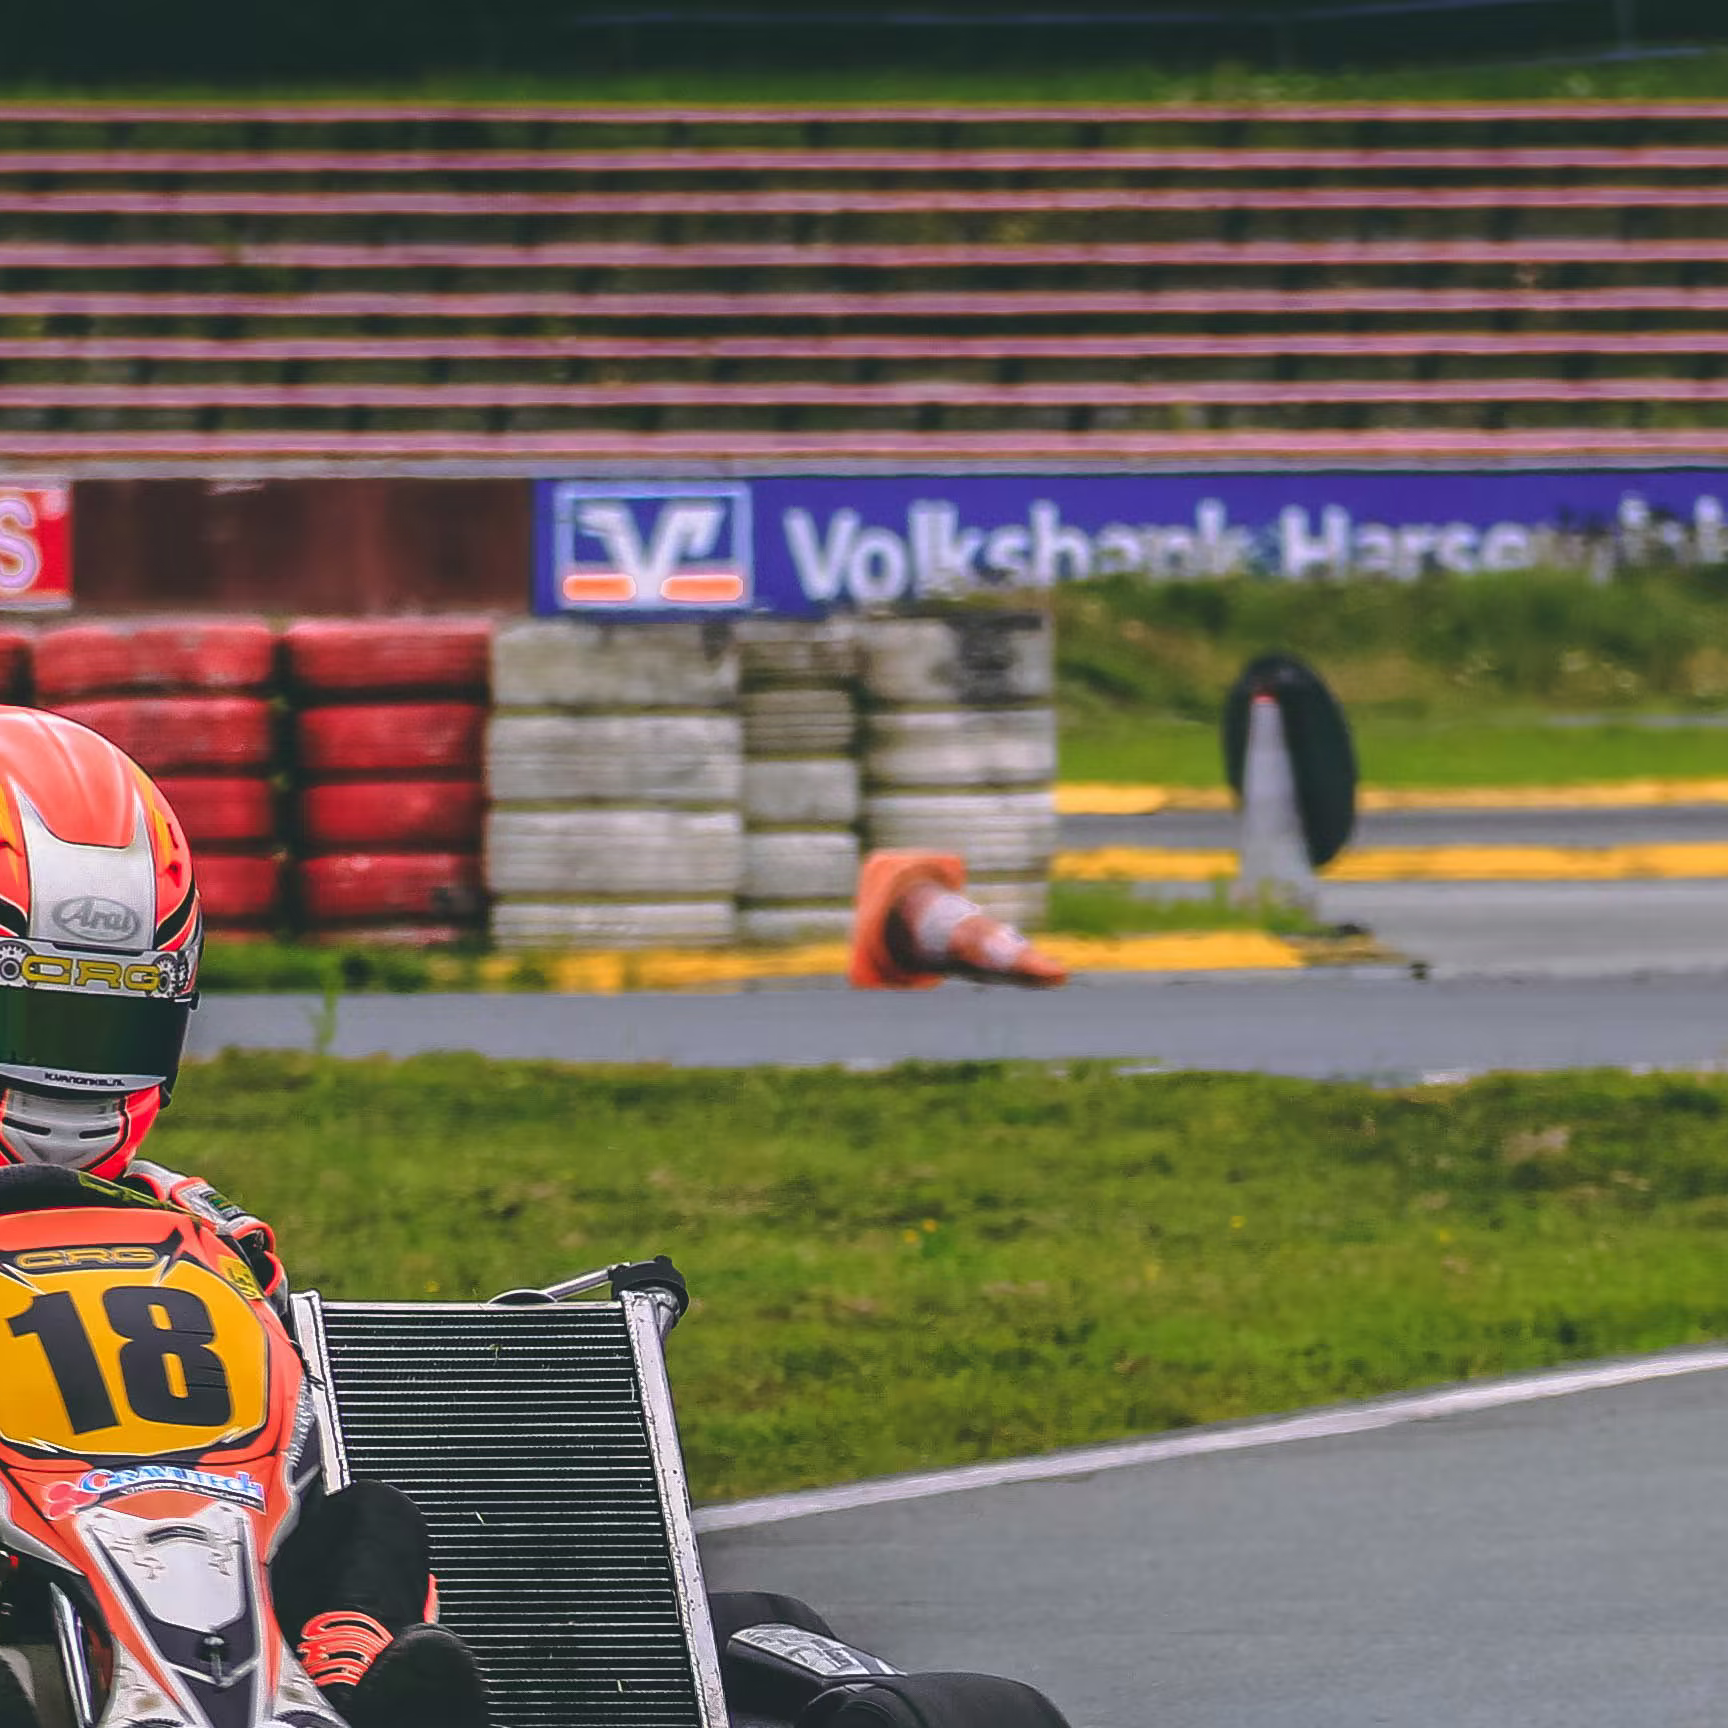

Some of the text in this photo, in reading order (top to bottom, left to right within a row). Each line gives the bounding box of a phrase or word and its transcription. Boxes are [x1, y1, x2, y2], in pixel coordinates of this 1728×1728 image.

[60, 898, 138, 932] Arai
[21, 955, 162, 991] CRG
[15, 1247, 159, 1270] CRG
[6, 1285, 235, 1436] 18
